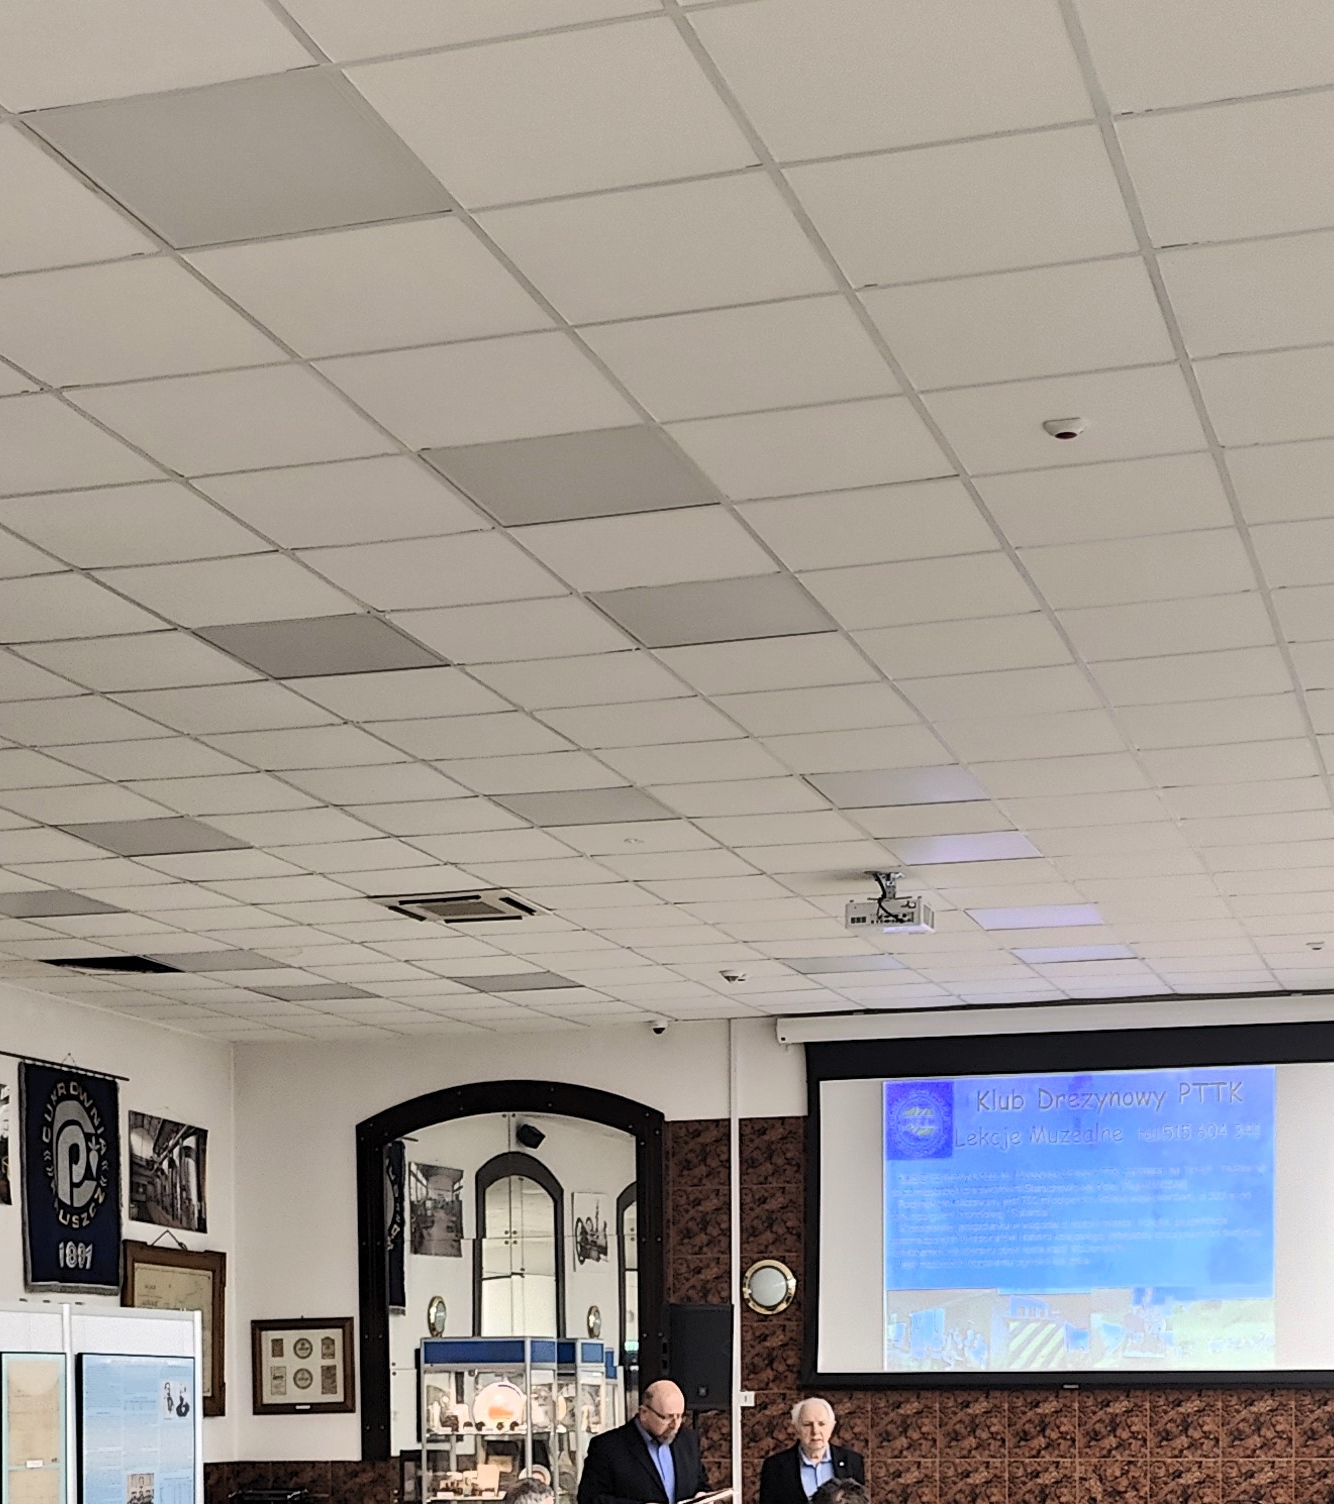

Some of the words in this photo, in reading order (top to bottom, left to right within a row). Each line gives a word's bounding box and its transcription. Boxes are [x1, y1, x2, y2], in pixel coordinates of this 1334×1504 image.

[977, 1088, 1025, 1112] Klub
[1038, 1087, 1167, 1114] Drezynowy
[1179, 1081, 1243, 1104] PTTK
[42, 1081, 107, 1156] CUKROWNIA
[955, 1125, 1021, 1150] Lekcje
[1029, 1122, 1124, 1145] Muzealne
